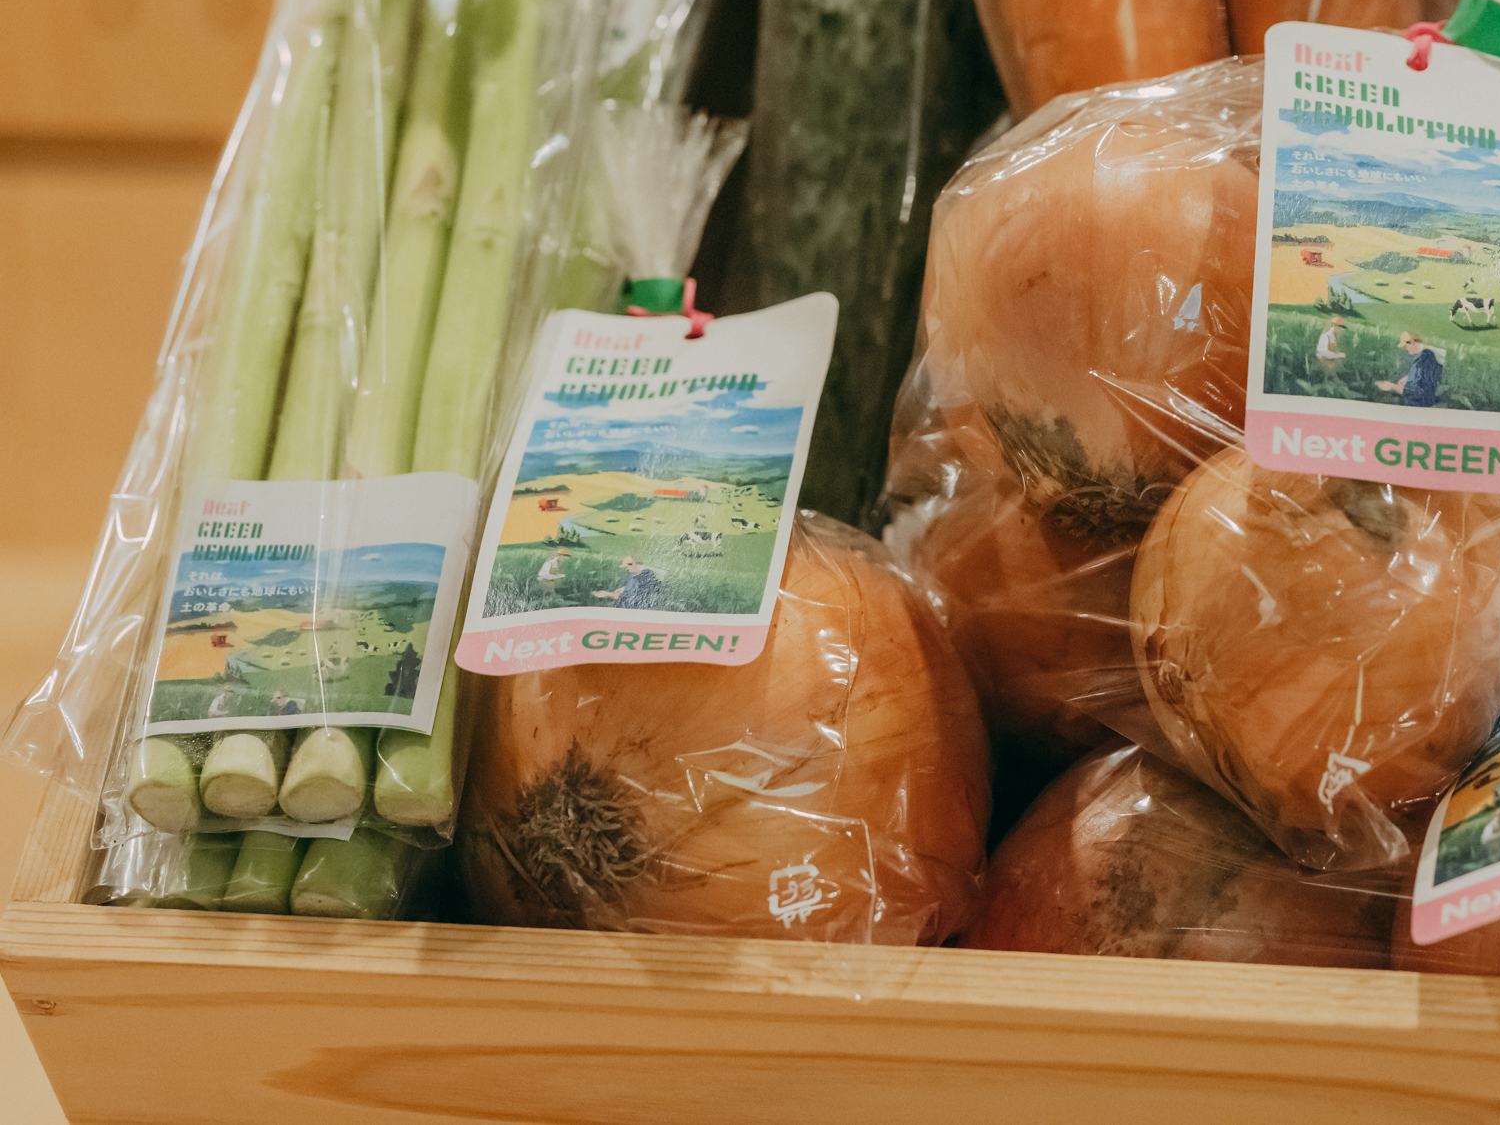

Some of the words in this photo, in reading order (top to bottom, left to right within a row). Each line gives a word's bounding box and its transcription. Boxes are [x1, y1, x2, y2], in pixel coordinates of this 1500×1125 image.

[1295, 71, 1400, 108] GREEN
[1293, 98, 1496, 150] REVOLUTION
[566, 357, 671, 376] GREEN
[1272, 426, 1367, 463] Next
[197, 521, 264, 539] GREEN
[482, 630, 575, 664] Next
[581, 629, 741, 653] GREEN!
